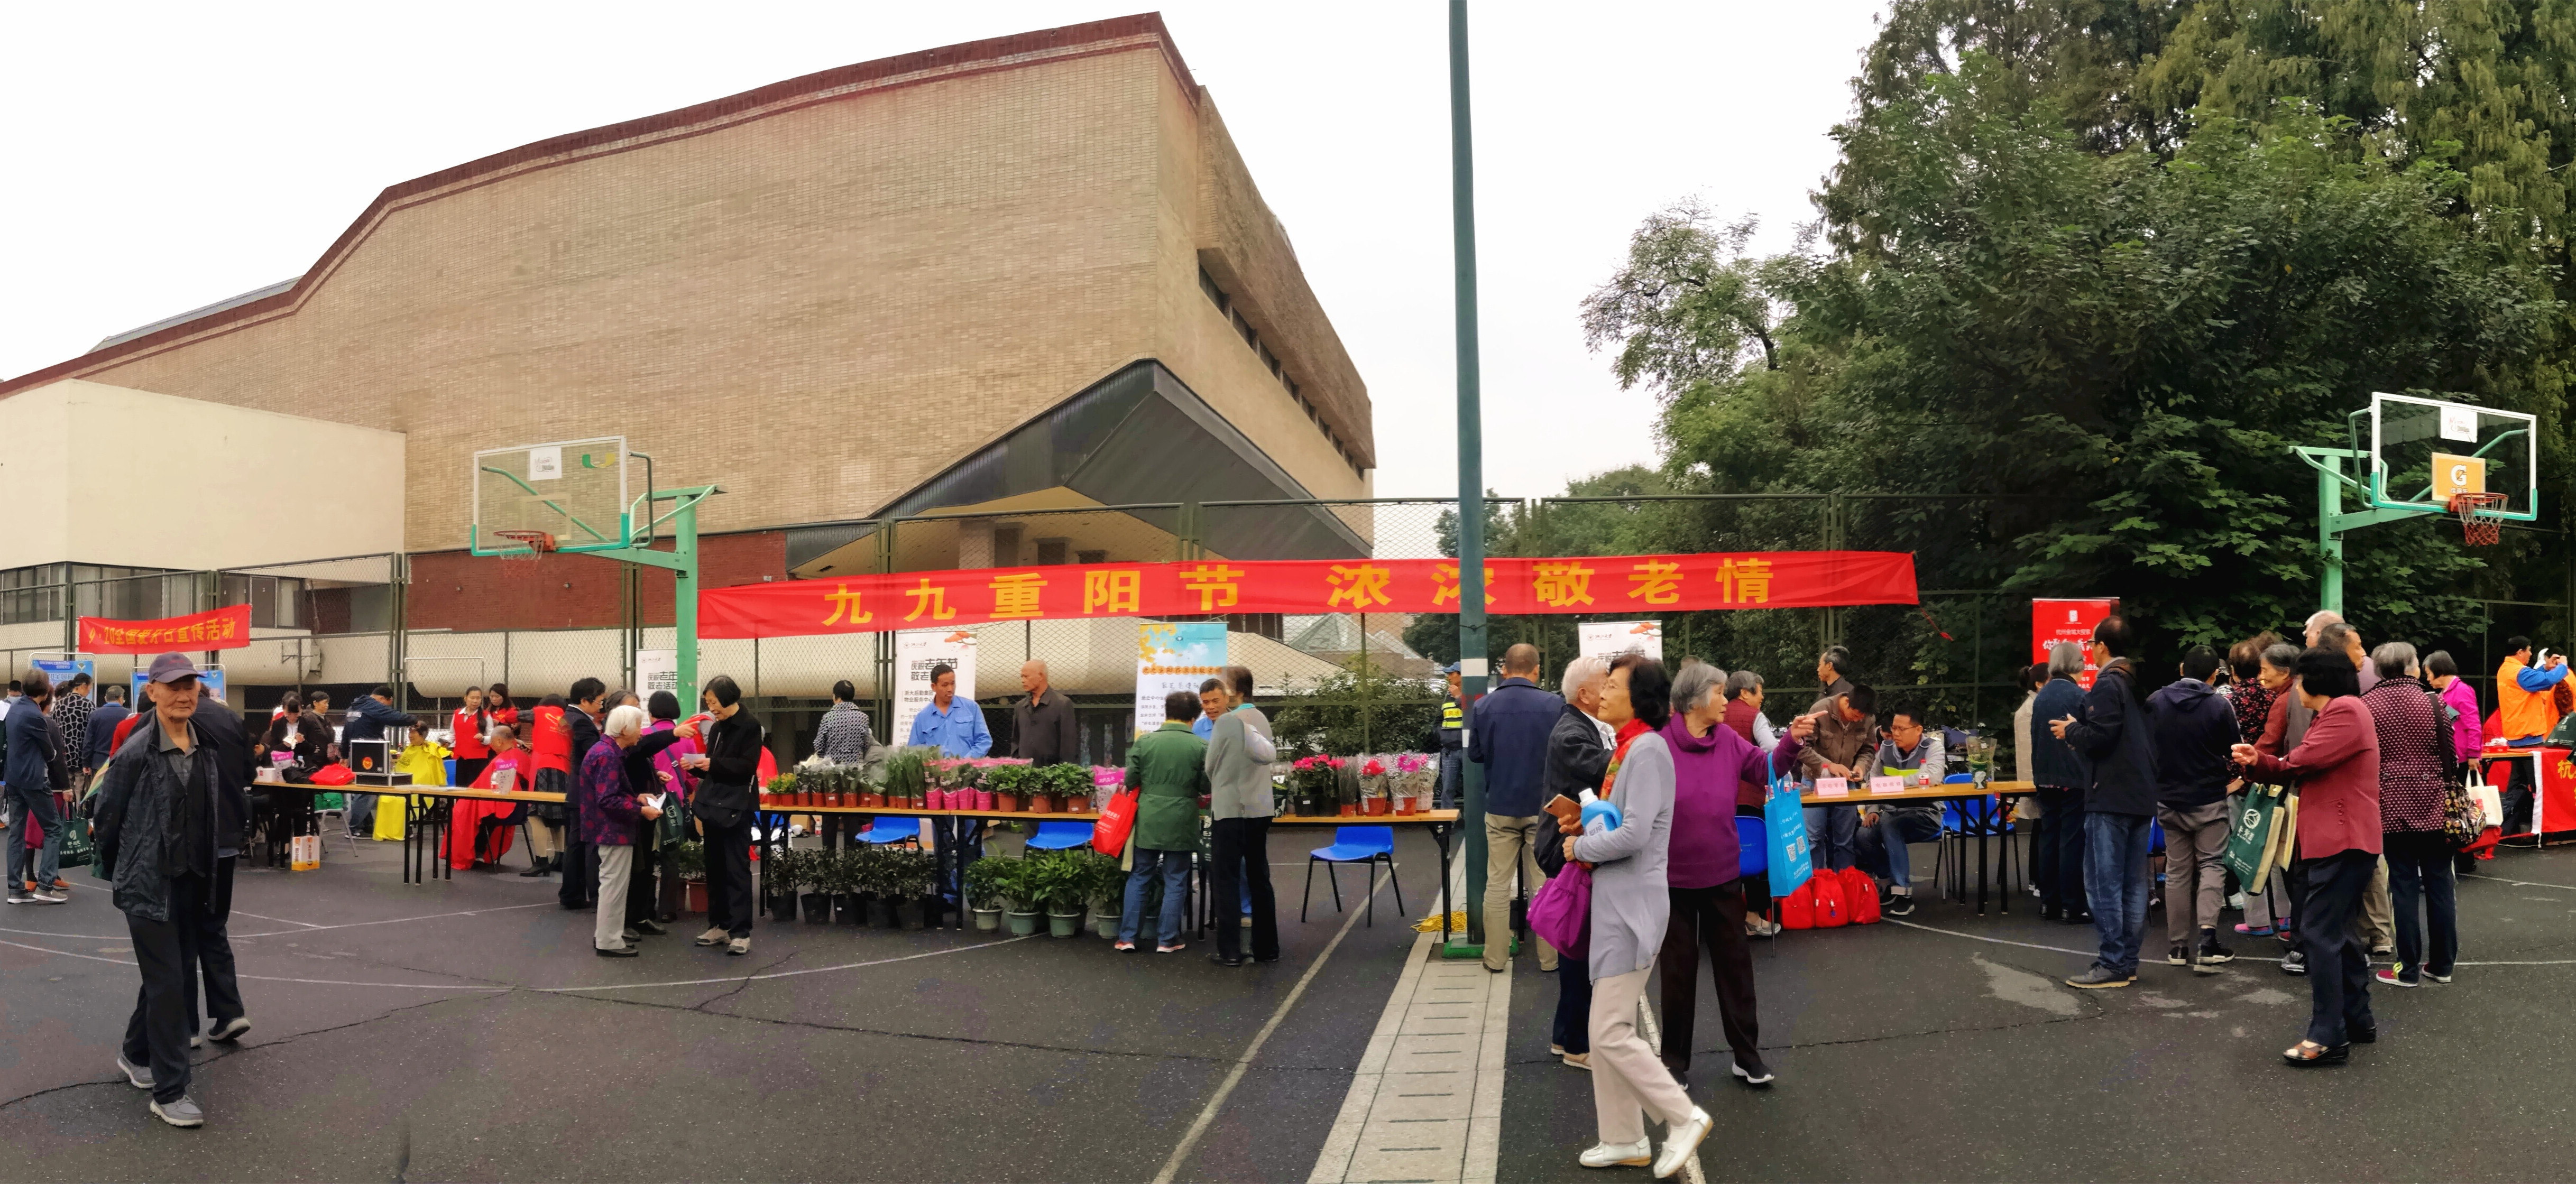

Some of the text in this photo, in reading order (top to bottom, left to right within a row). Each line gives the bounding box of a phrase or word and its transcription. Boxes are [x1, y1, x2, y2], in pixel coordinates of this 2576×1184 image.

[2451, 465, 2467, 486] G
[823, 558, 1774, 626] 九九重阳节 浓浓敬老情
[2557, 760, 2576, 780] 杭
